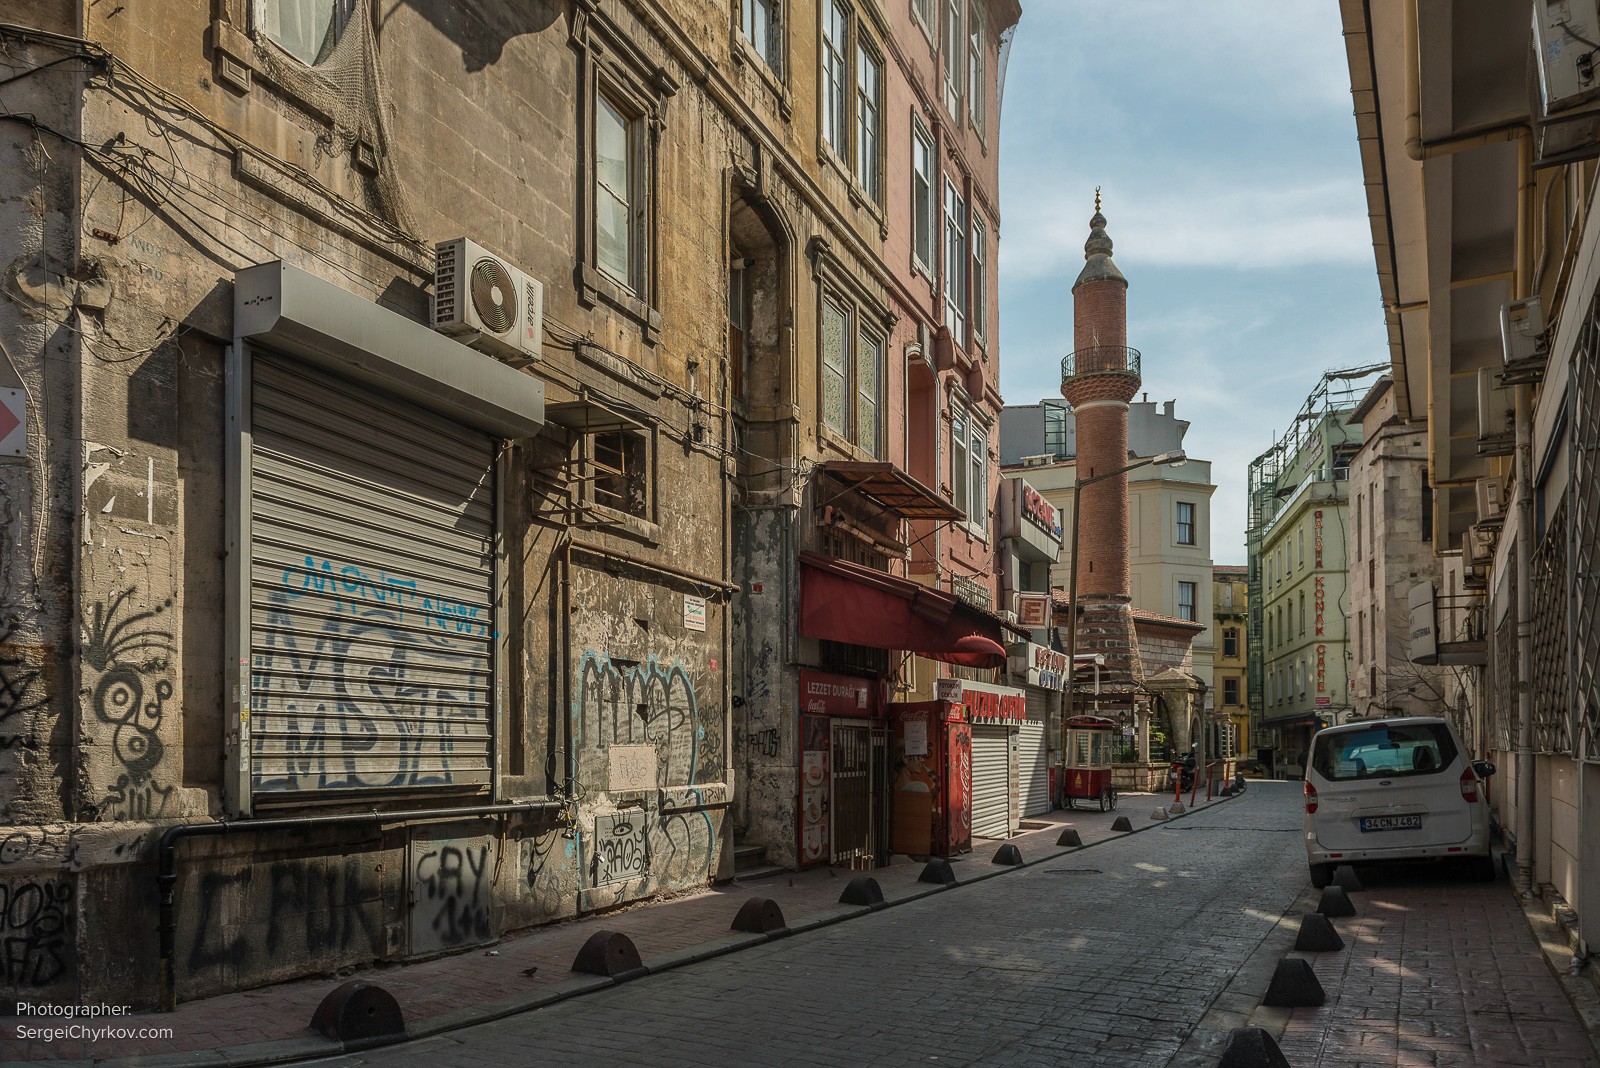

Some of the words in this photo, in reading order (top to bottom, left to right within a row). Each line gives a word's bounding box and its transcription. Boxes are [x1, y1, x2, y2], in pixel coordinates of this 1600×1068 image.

[526, 281, 536, 327] arçelik
[1023, 485, 1056, 531] ECZANE
[1314, 510, 1324, 569] GALATA
[1314, 575, 1325, 636] KONAK
[807, 682, 831, 695] LEZZET
[832, 684, 855, 698] DURAĞI
[1316, 644, 1326, 693] CAFE
[961, 689, 999, 719] HUZUR
[960, 750, 971, 829] Coca-Cola
[1366, 819, 1379, 828] 34
[1380, 817, 1399, 828] CNJ
[1400, 816, 1419, 826] 482
